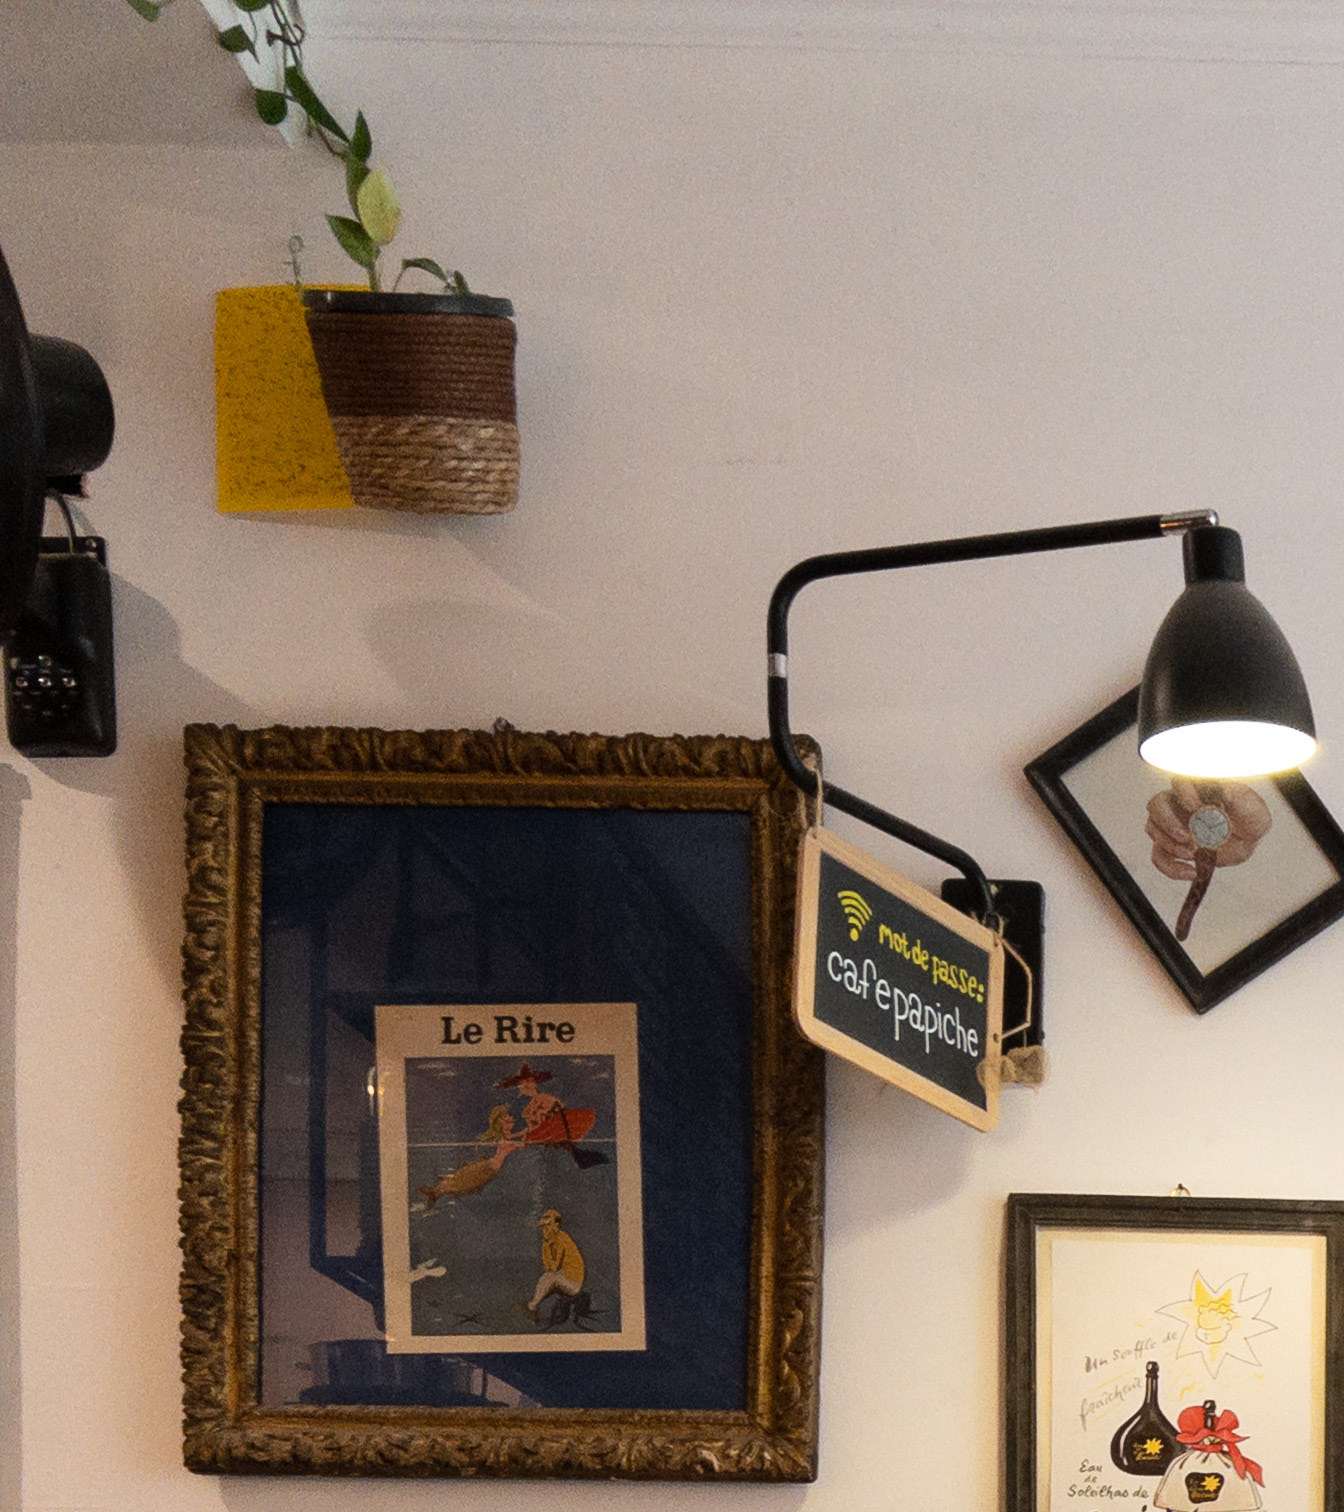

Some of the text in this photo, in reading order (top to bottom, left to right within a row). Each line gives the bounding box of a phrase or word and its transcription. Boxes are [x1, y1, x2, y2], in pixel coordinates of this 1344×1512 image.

[878, 922, 911, 961] mot
[910, 940, 929, 970] de
[441, 1014, 576, 1045] Le Rire
[1079, 1459, 1103, 1473] Eau
[1084, 1475, 1097, 1483] de
[1132, 1485, 1150, 1498] de
